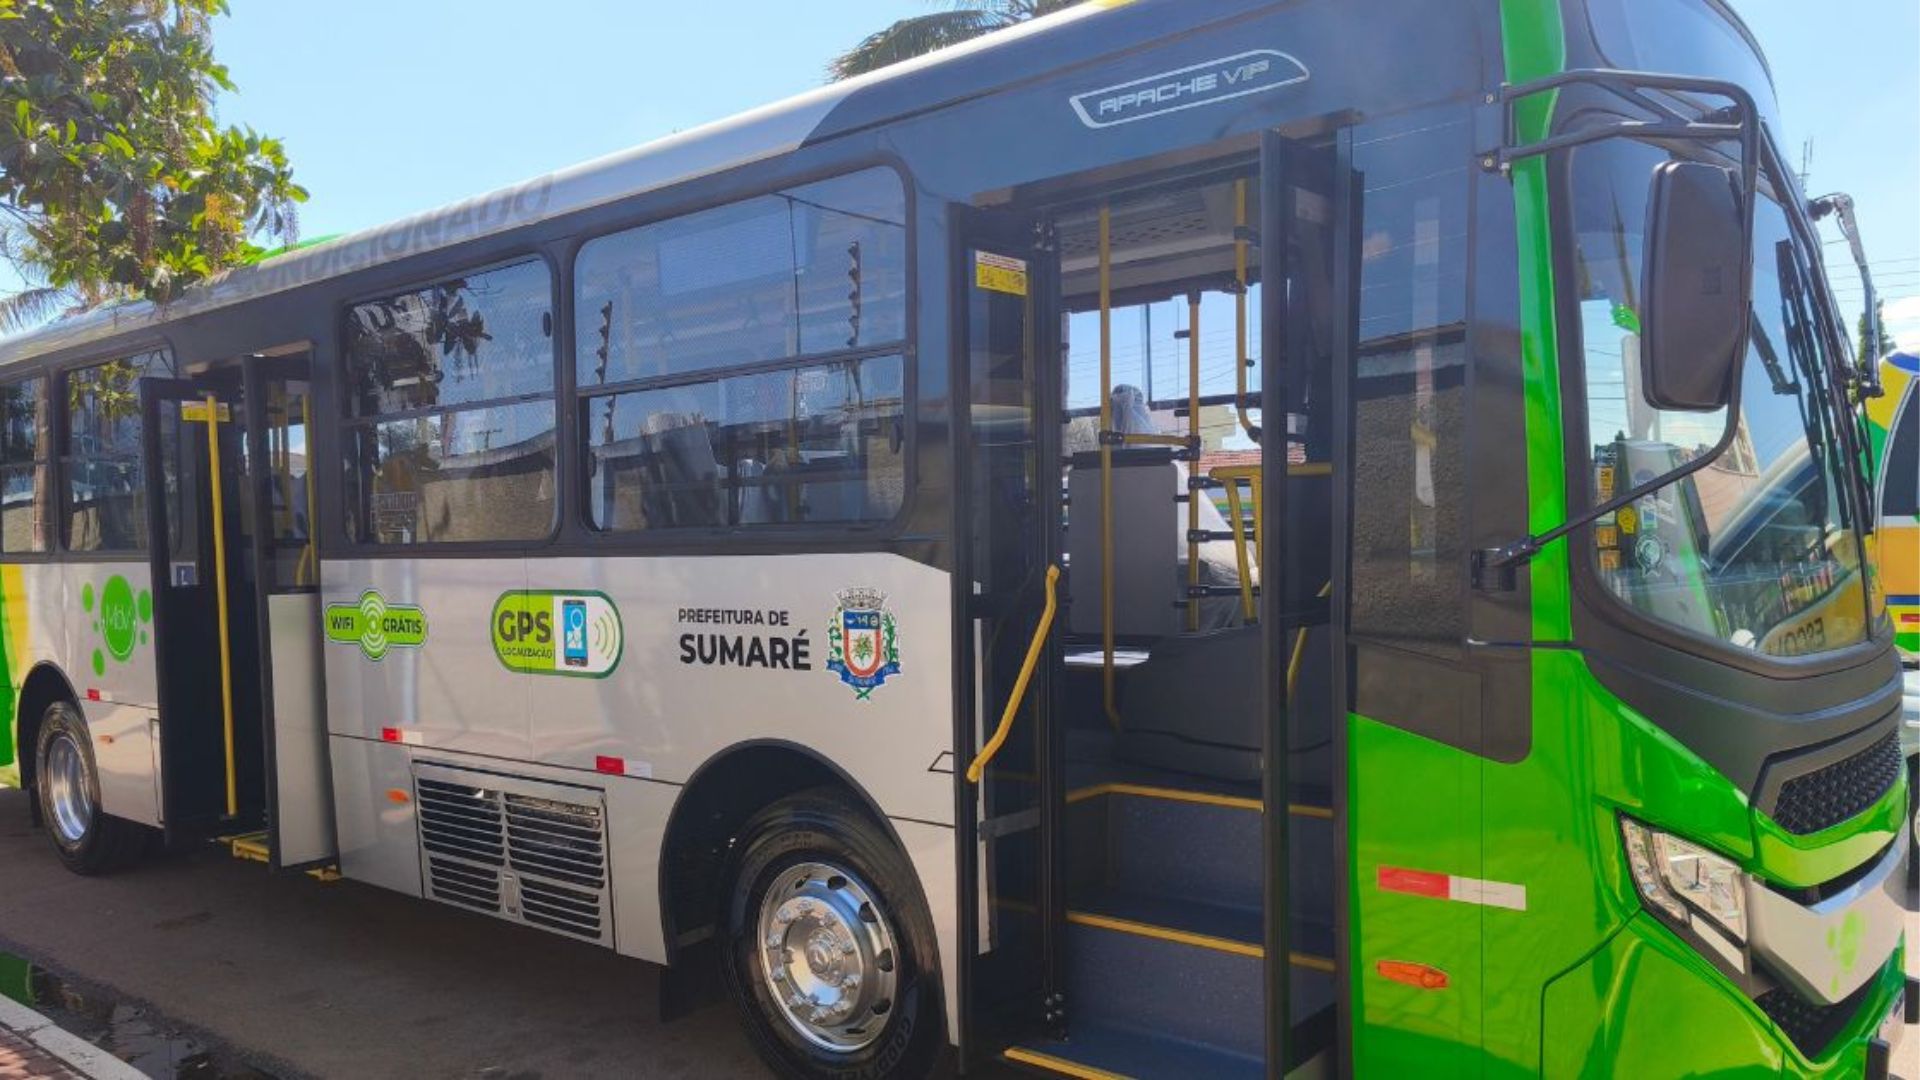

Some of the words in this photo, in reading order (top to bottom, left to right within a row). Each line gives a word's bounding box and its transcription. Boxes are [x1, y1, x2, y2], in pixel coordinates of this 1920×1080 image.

[1099, 73, 1218, 117] APACHE
[1222, 59, 1270, 85] VIP
[330, 616, 355, 631] WIFI
[382, 615, 423, 634] GRÁTIS
[498, 609, 552, 644] GPS
[678, 608, 764, 625] PREFEITURA
[768, 610, 789, 626] DE
[500, 645, 554, 659] LOCALIZAÇÃO
[680, 628, 811, 670] SUMARÉ
